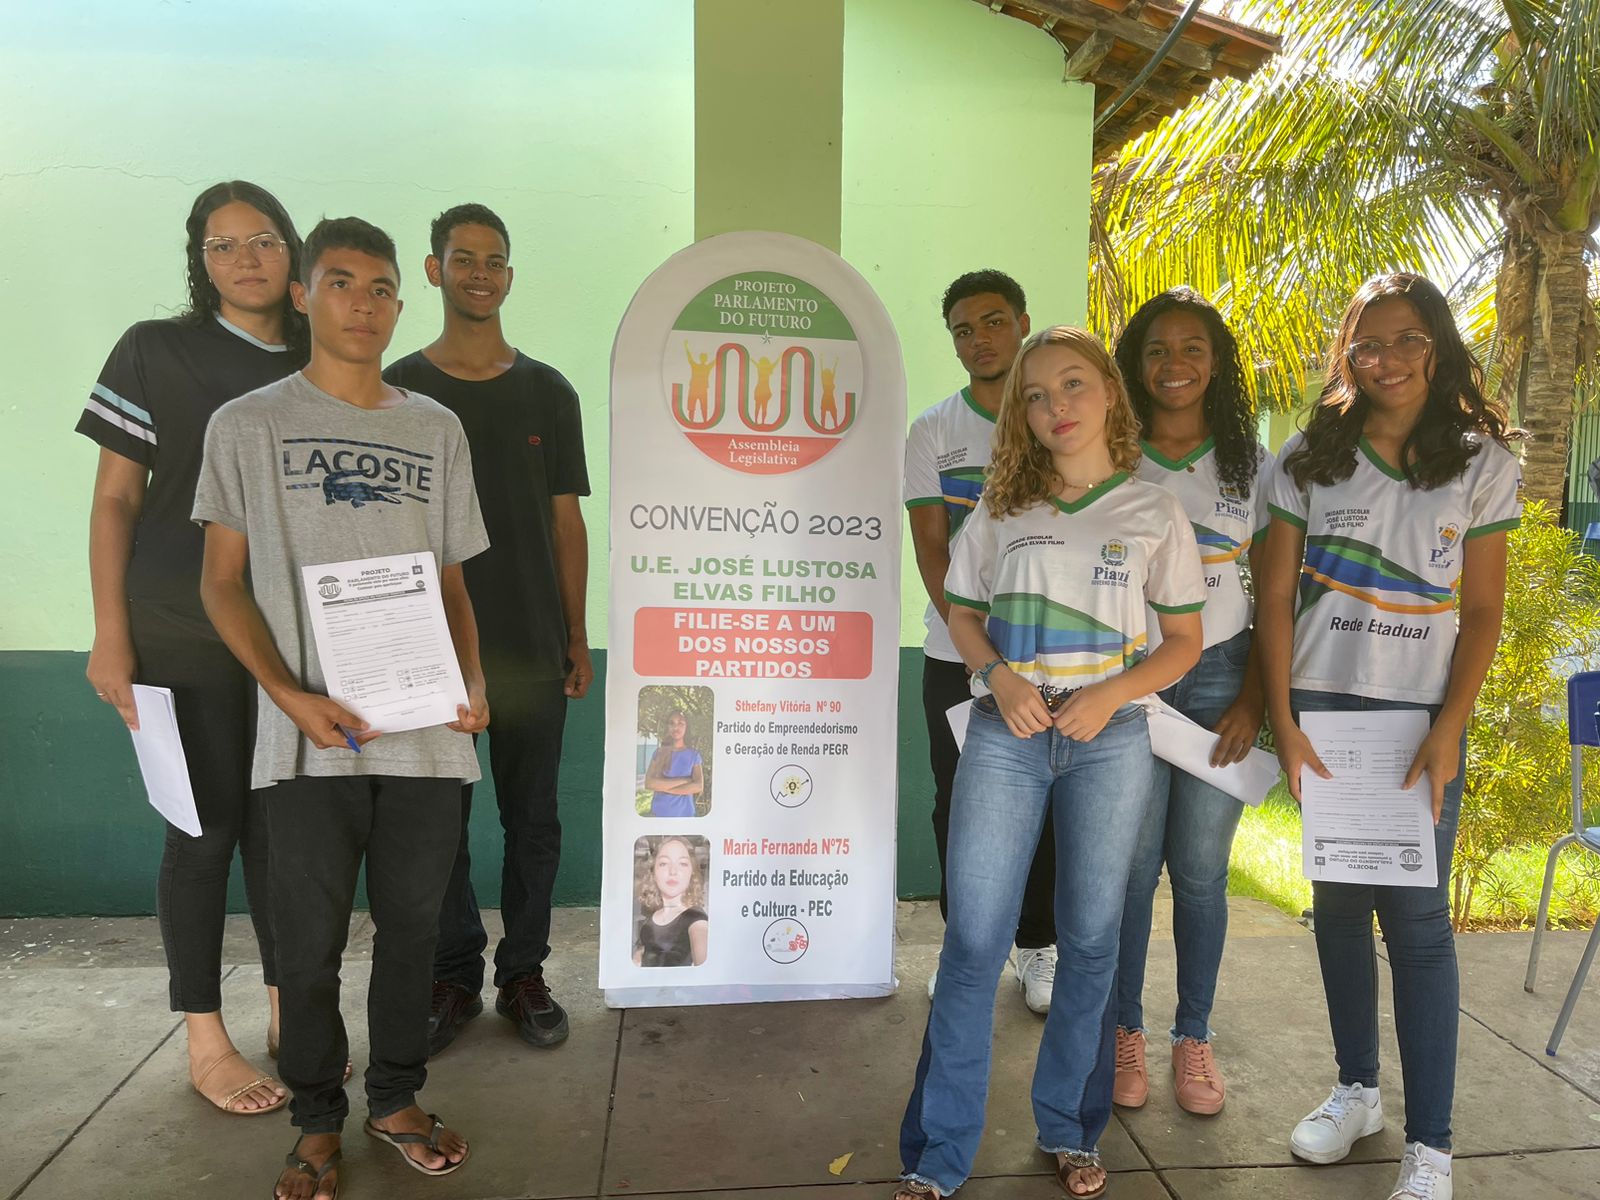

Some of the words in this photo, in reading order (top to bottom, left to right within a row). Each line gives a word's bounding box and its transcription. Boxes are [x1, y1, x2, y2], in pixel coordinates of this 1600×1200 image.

[734, 280, 796, 294] PROJETO
[714, 294, 818, 314] PARLAMENTO
[720, 312, 744, 326] DO
[749, 312, 812, 330] FUTURO
[728, 438, 800, 452] Assembleia
[729, 451, 798, 466] Legislativa
[283, 449, 432, 492] LACOSTE
[630, 501, 800, 538] CONVENÇÃO
[808, 515, 882, 540] 2023
[630, 556, 679, 574] U.E.
[688, 555, 754, 576] JOSÉ
[762, 559, 877, 579] LUSTOSA
[674, 582, 753, 601] ELVAS
[762, 585, 836, 604] FILHO
[674, 612, 769, 631] FILIE-SE
[776, 614, 793, 631] A
[801, 615, 836, 632] UM
[1330, 616, 1363, 631] Rede
[1368, 619, 1430, 640] Etadual
[678, 636, 727, 653] DOS
[734, 637, 830, 655] NOSSOS
[696, 660, 812, 678] PARTIDOS
[736, 700, 776, 715] Sthefany
[780, 700, 811, 712] Vitória
[830, 700, 841, 712] 90
[717, 721, 751, 734] Partido
[754, 722, 766, 734] do
[768, 722, 858, 736] Empreendedorismo
[726, 746, 732, 755] e
[734, 743, 774, 757] Geração
[776, 743, 788, 755] de
[791, 744, 820, 755] Renda
[822, 744, 849, 755] PEGR
[723, 838, 757, 855] Maria
[761, 838, 818, 855] Fernanda
[722, 870, 767, 887] Partido
[771, 870, 785, 887] da
[789, 870, 849, 890] Educação
[741, 905, 748, 917] e
[753, 901, 797, 917] Cultura
[808, 901, 832, 916] PEC
